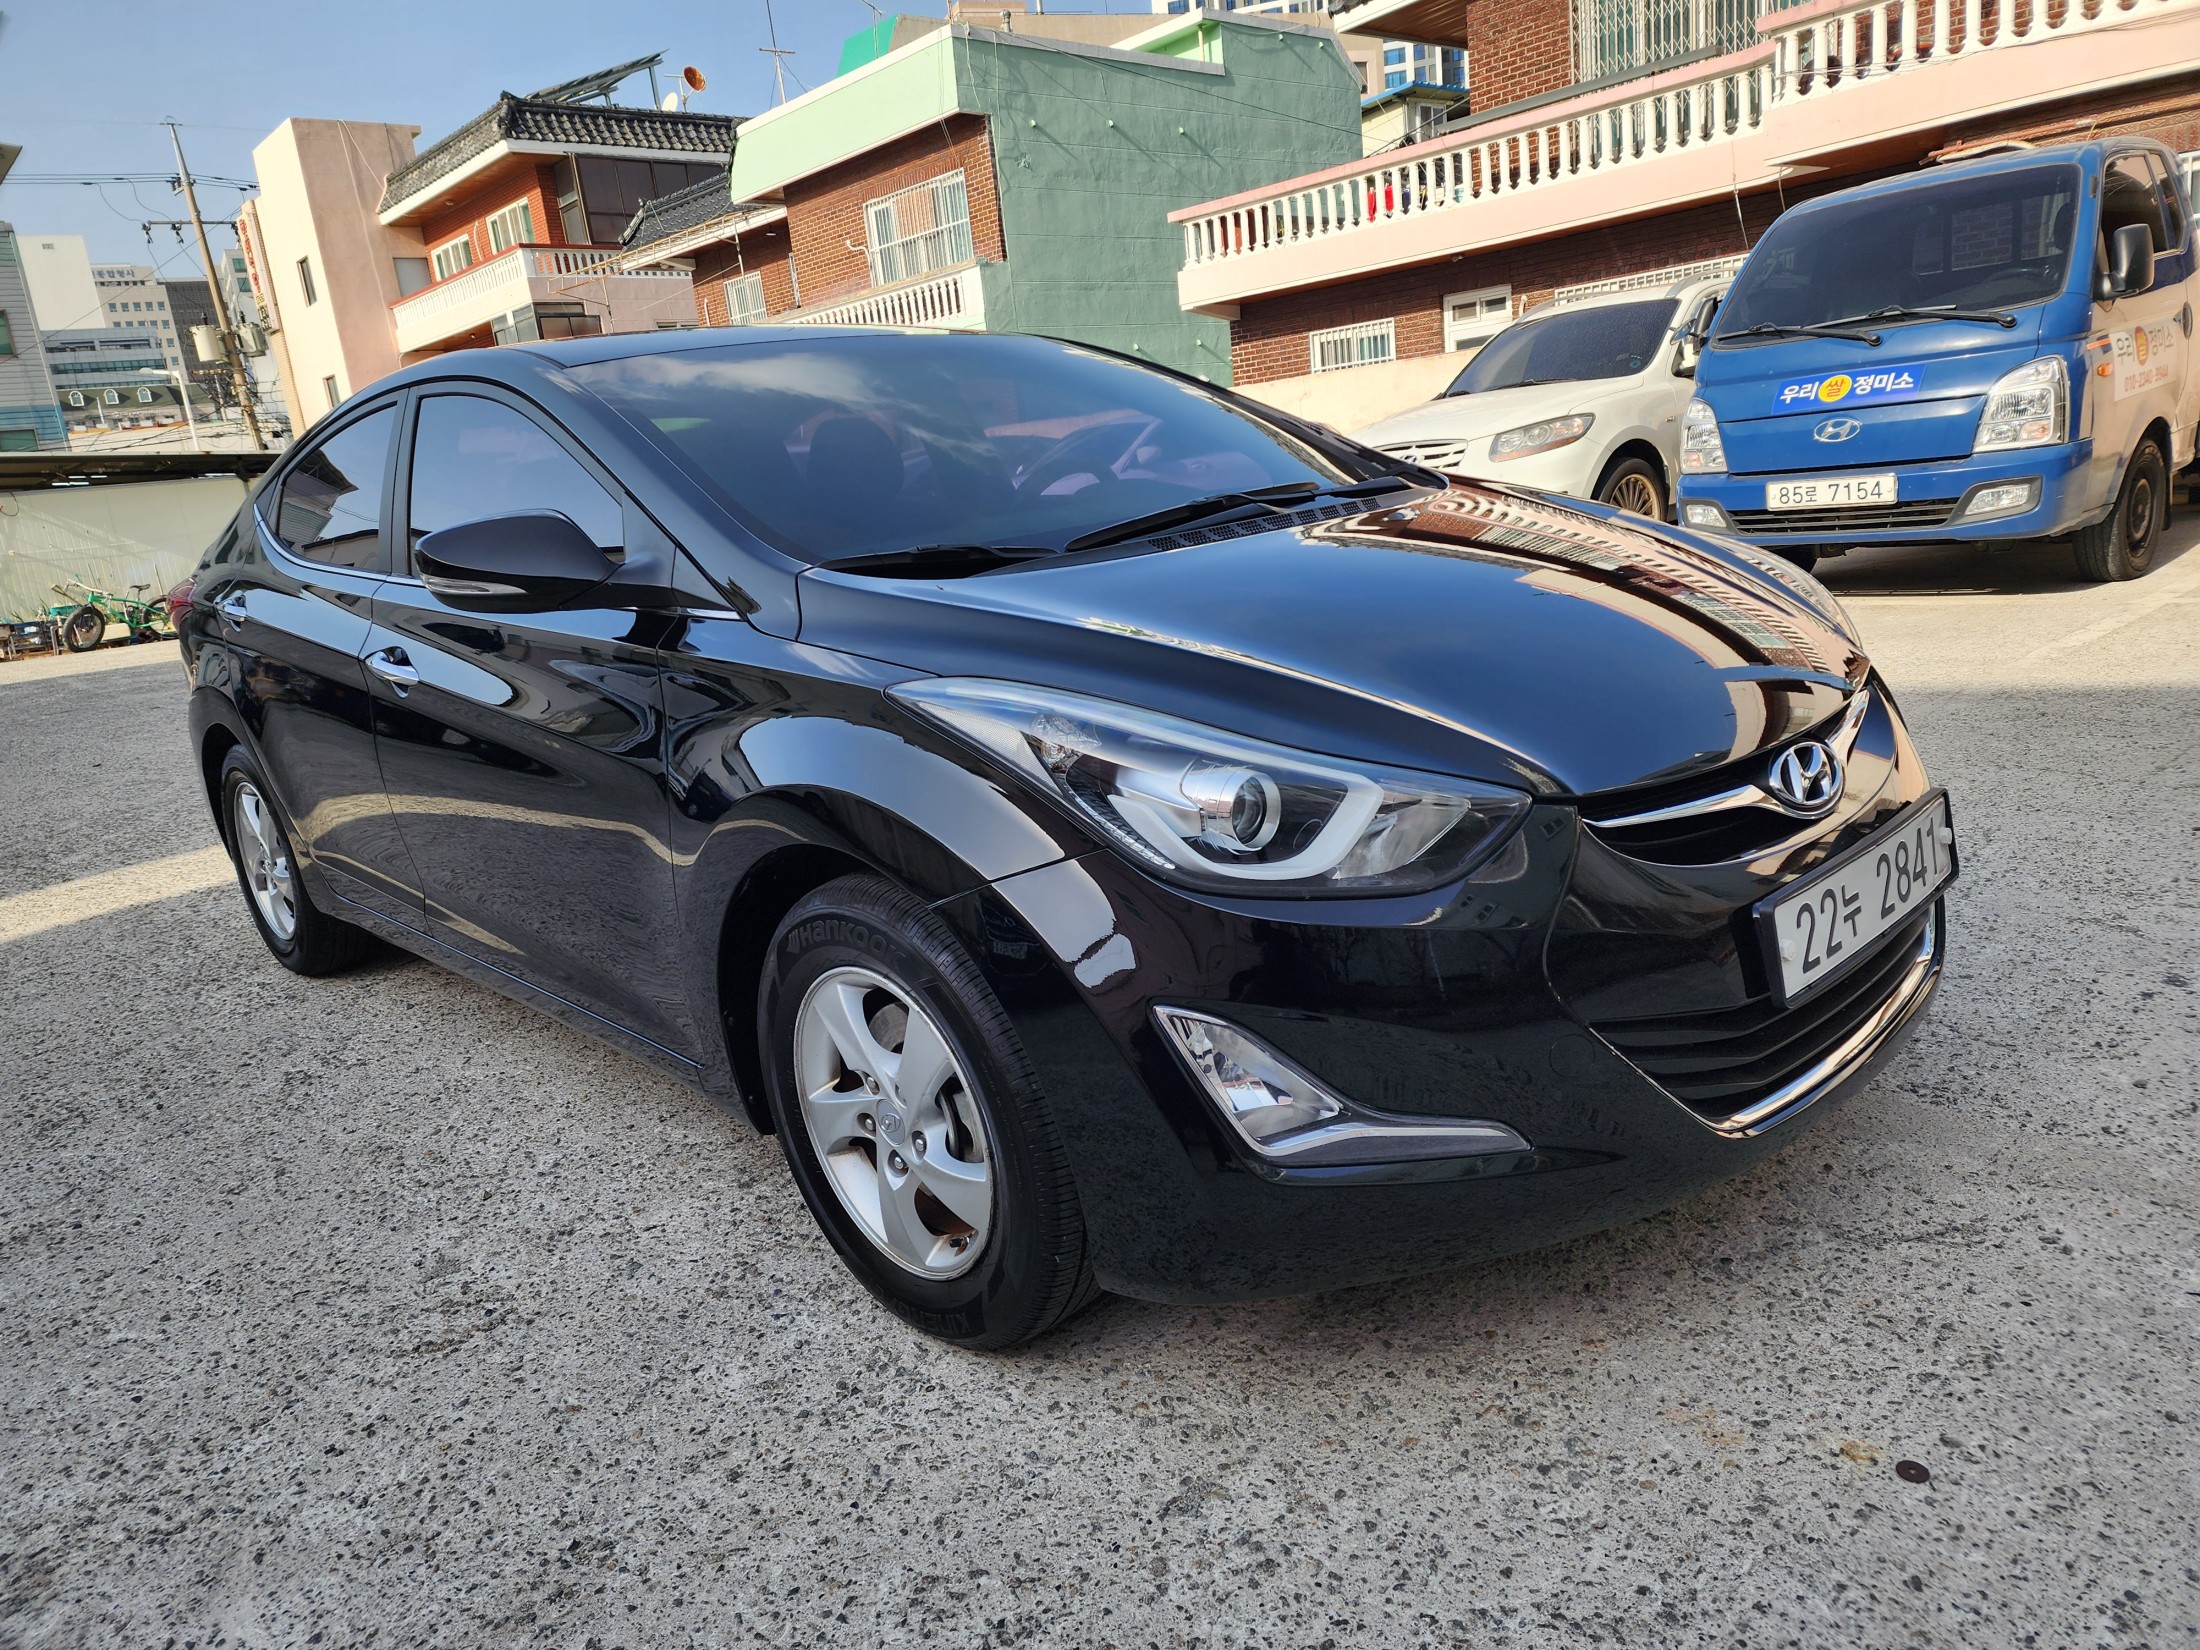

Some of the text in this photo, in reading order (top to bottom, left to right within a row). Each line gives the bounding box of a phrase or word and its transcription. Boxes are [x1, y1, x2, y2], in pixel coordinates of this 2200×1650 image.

[2116, 333, 2136, 365] 우리
[2148, 325, 2174, 356] 정미소
[1780, 372, 1914, 404] 우리 쌀 정미소
[1779, 480, 1883, 504] 85로 7154
[1796, 816, 1938, 974] 22누 2841
